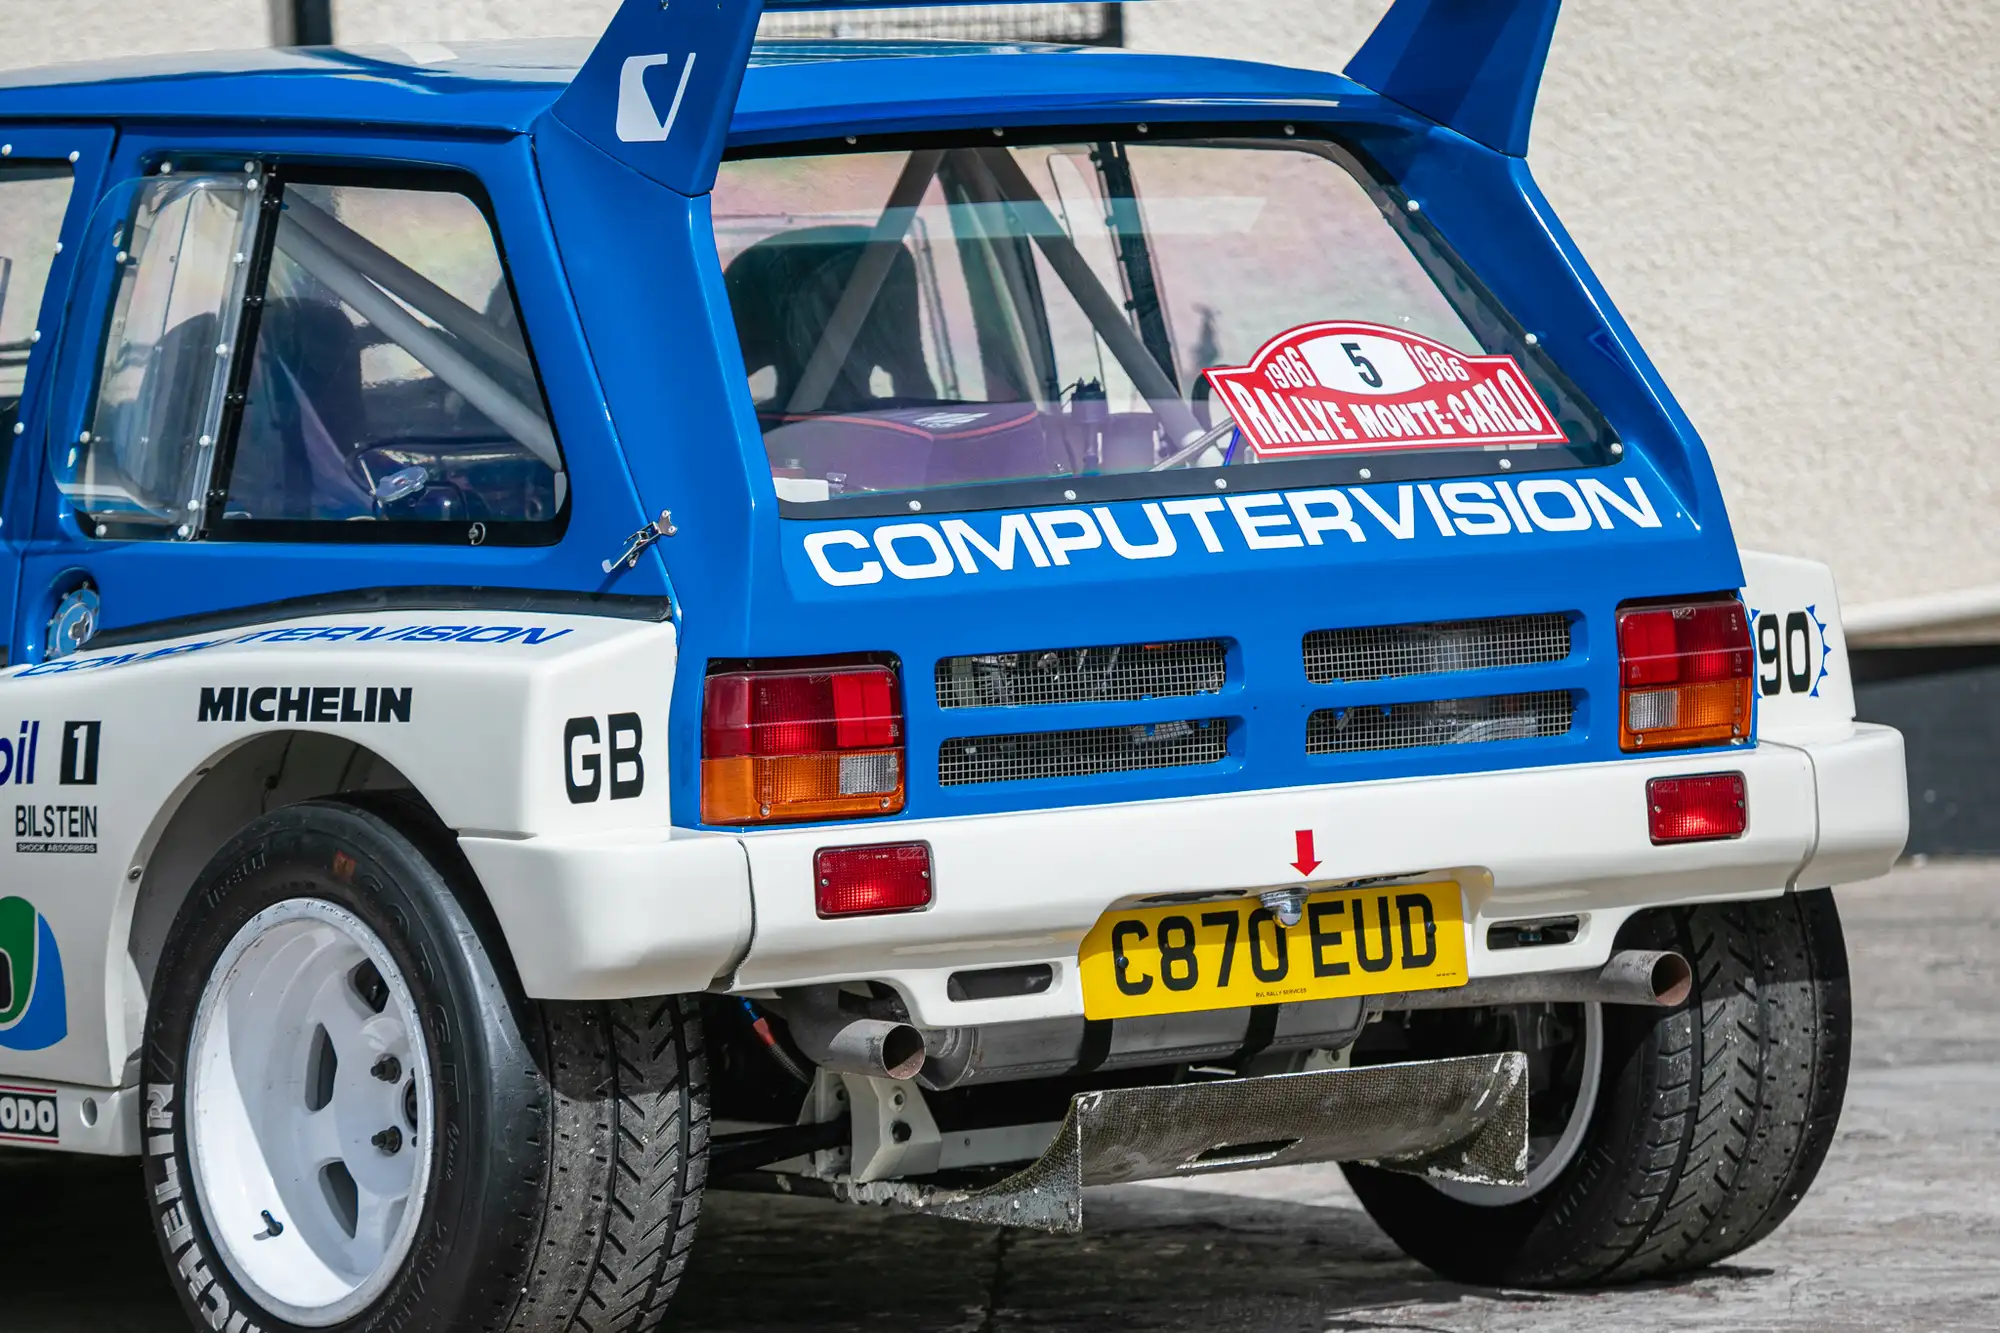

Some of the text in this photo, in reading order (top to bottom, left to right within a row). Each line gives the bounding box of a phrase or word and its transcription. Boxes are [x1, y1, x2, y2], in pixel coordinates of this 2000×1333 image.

[1264, 342, 1470, 389] 1986 5 1986
[1225, 369, 1542, 444] RALLYE MONTE-CARLO
[804, 478, 1662, 586] COMPUTERVISION
[1758, 609, 1811, 696] 90
[198, 687, 412, 722] MICHELIN
[564, 712, 644, 804] GB
[15, 804, 98, 838] BILSTEIN
[18, 843, 96, 853] SHOCK ABSORBERS
[1112, 893, 1436, 996] C870 EUD
[1283, 986, 1307, 996] SERVICES
[147, 1083, 263, 1333] ICHELIN
